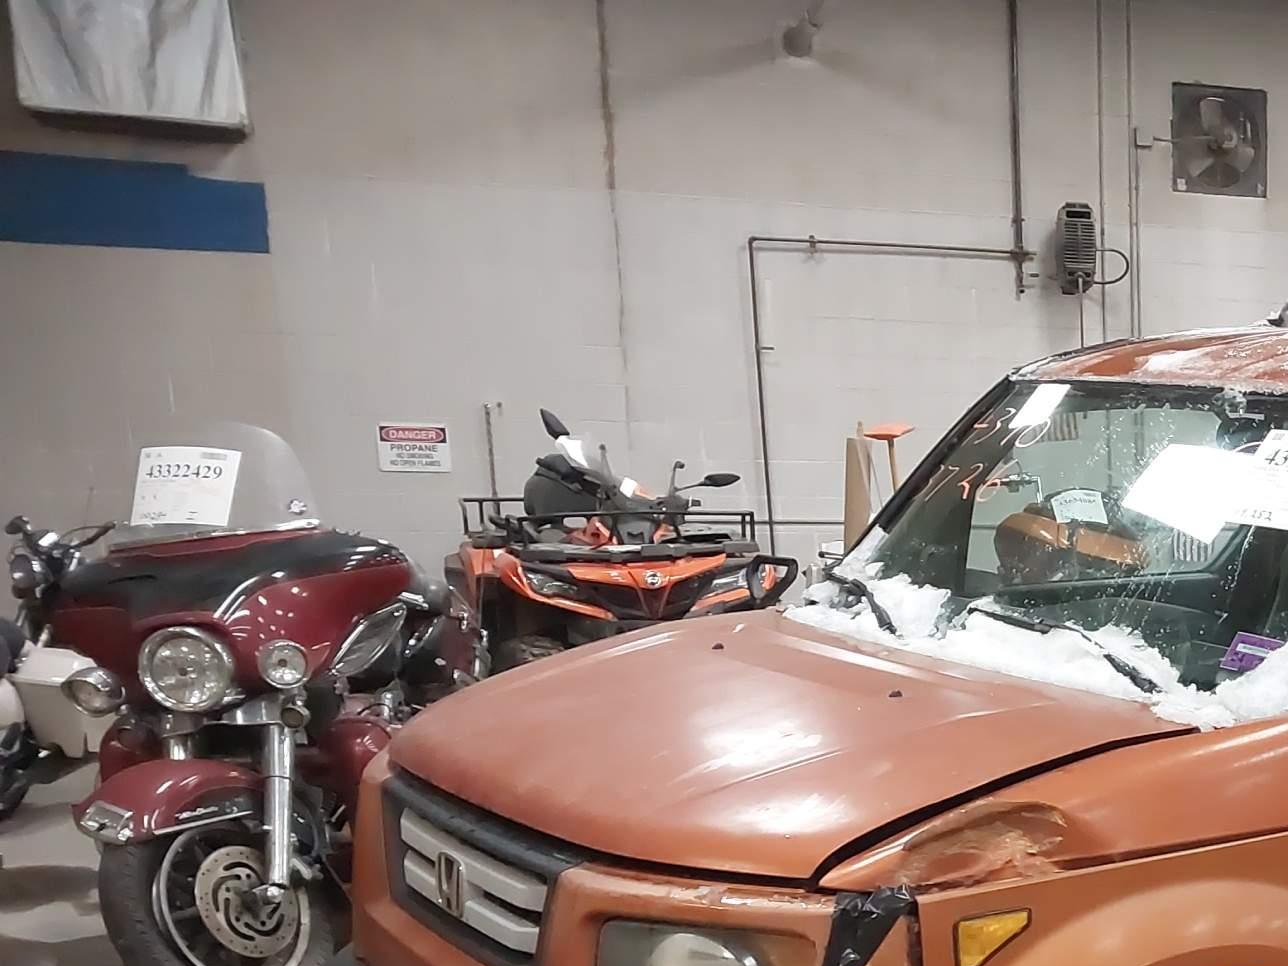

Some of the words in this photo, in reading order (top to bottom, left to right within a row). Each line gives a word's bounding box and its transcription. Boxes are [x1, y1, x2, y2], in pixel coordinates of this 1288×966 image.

[388, 429, 437, 440] DANGER
[390, 444, 438, 452] PROPANE
[145, 463, 223, 479] 43322429
